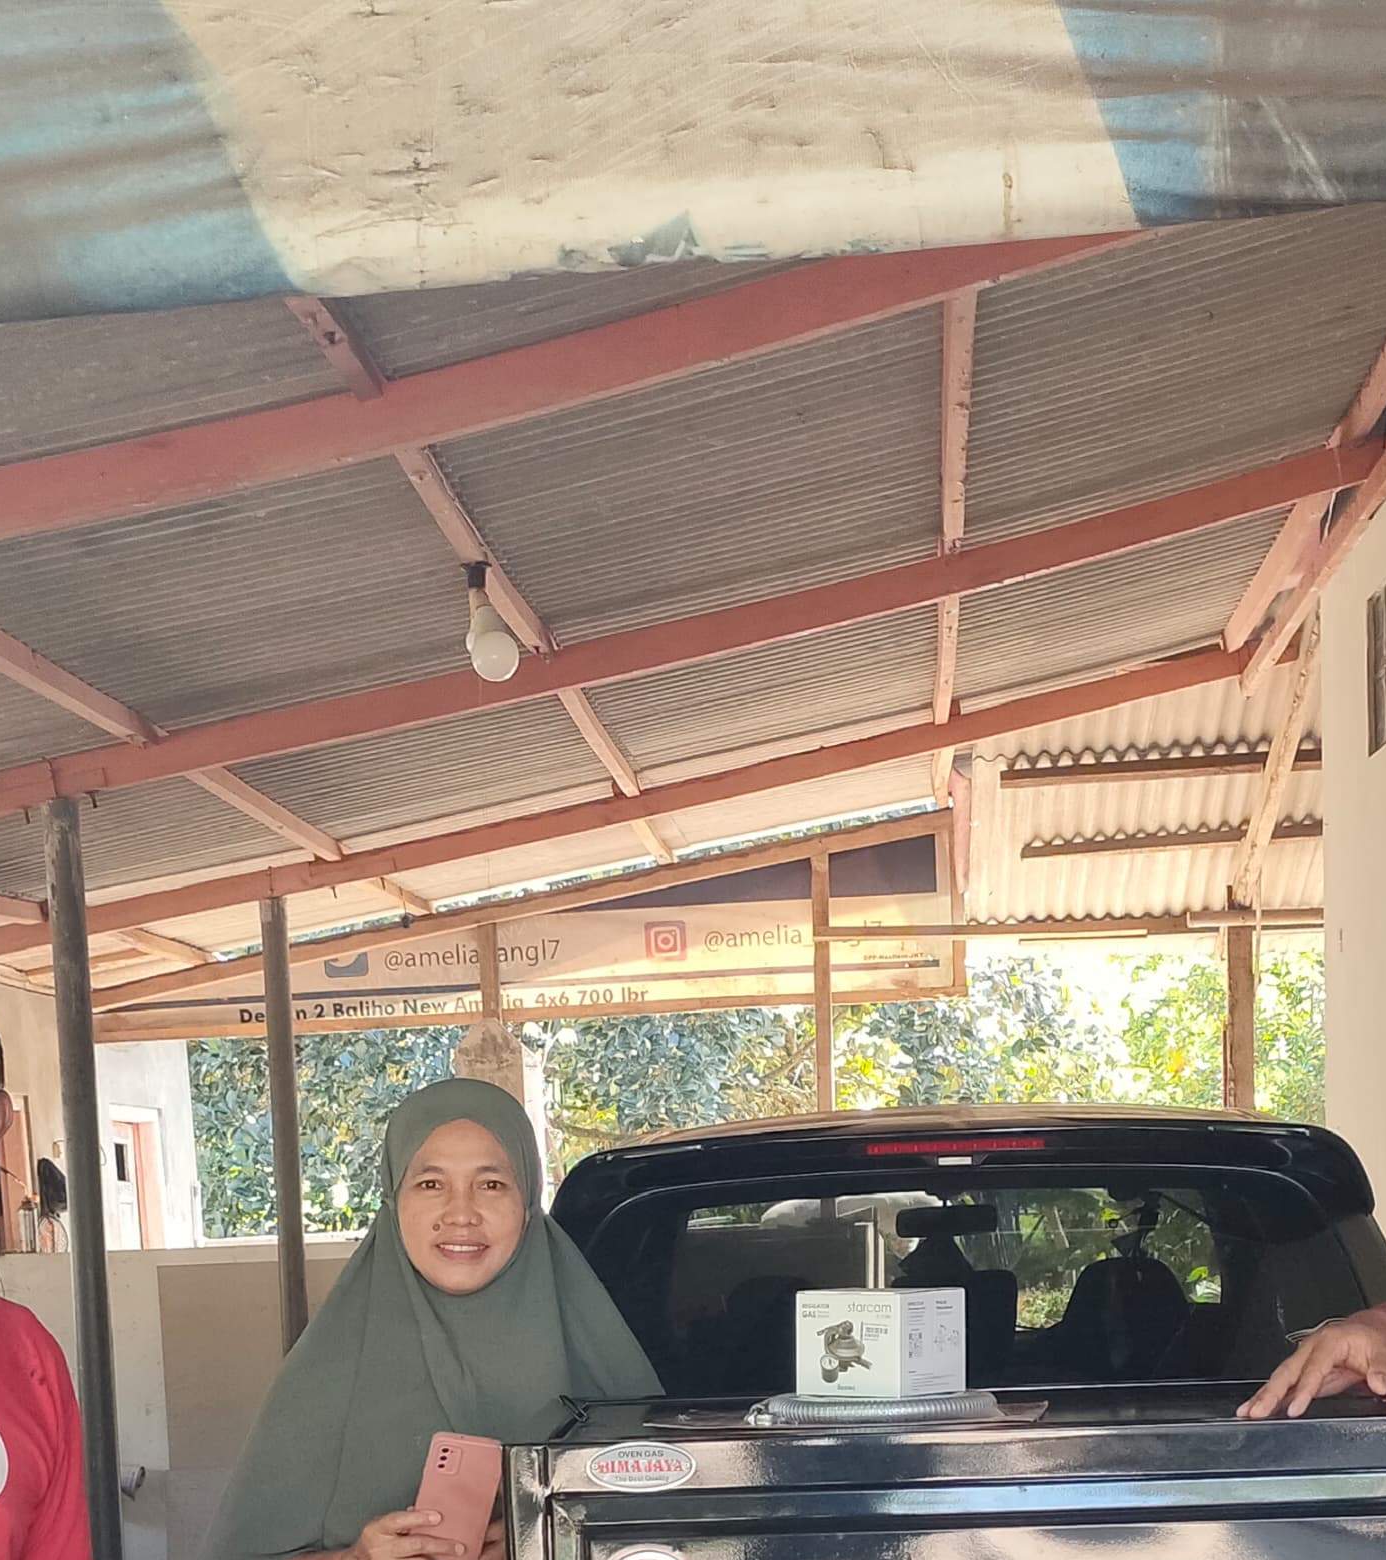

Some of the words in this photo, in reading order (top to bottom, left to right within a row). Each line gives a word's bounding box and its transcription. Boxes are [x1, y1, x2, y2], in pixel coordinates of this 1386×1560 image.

[240, 1008, 307, 1023] Den
[315, 1004, 326, 1018] 2
[333, 1000, 395, 1018] Baliho
[403, 998, 447, 1016] New
[454, 994, 524, 1012] Amlia
[535, 991, 569, 1008] 4x6
[578, 988, 614, 1006] 700
[847, 1301, 892, 1313] starcam
